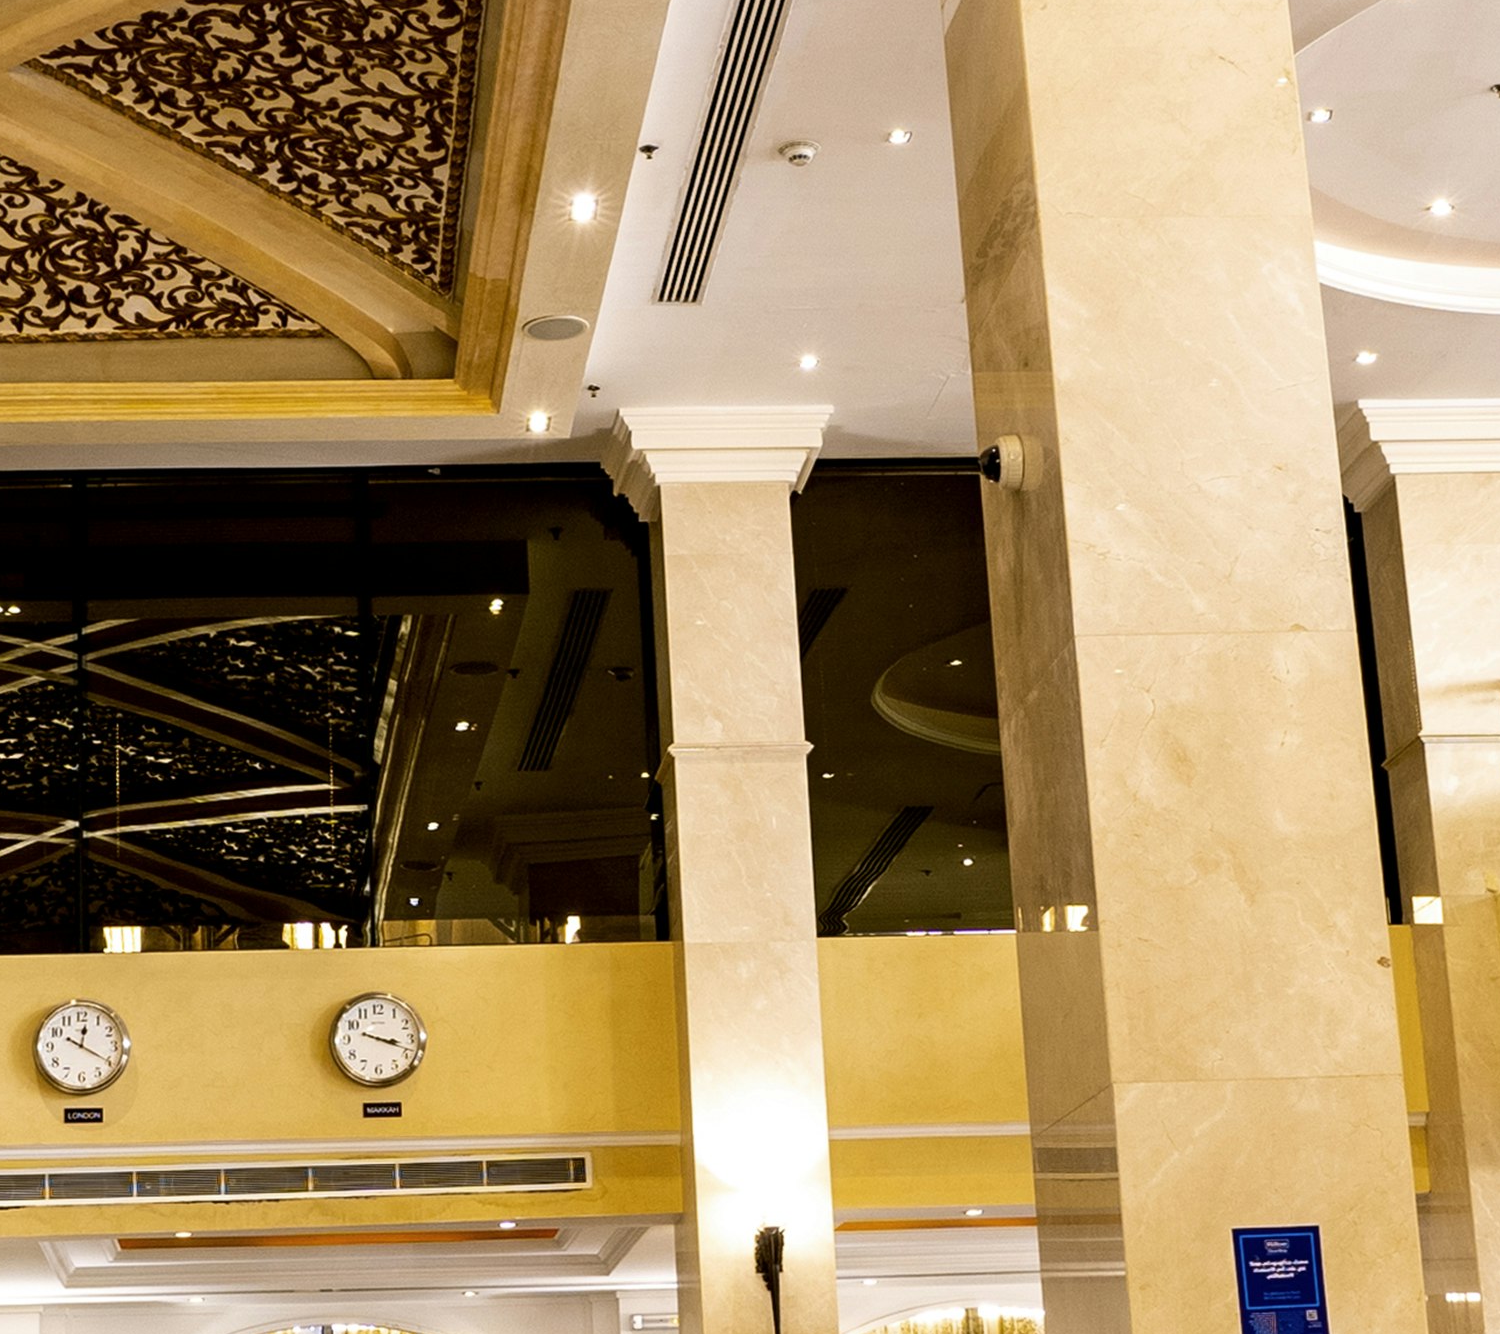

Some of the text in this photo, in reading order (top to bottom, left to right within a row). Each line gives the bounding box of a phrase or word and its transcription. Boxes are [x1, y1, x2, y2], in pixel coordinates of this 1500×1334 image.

[359, 1008, 368, 1019] 11
[373, 1004, 384, 1015] 12
[392, 1008, 396, 1019] 1
[62, 1016, 71, 1026] 11
[76, 1011, 88, 1022] 12
[96, 1015, 100, 1026] 1
[348, 1020, 359, 1031] 10
[402, 1019, 409, 1030] 2
[52, 1027, 63, 1038] 10
[105, 1026, 113, 1038] 2
[343, 1035, 351, 1045] 9
[407, 1034, 415, 1044] 3
[46, 1042, 54, 1053] 9
[111, 1041, 118, 1052] 3
[348, 1050, 356, 1060] 8
[52, 1057, 59, 1068] 8
[360, 1060, 368, 1071] 7
[392, 1060, 399, 1070] 5
[63, 1067, 70, 1079] 7
[94, 1067, 102, 1078] 5
[375, 1065, 383, 1075] 6
[78, 1072, 86, 1083] 6
[67, 1112, 101, 1120] LONDON
